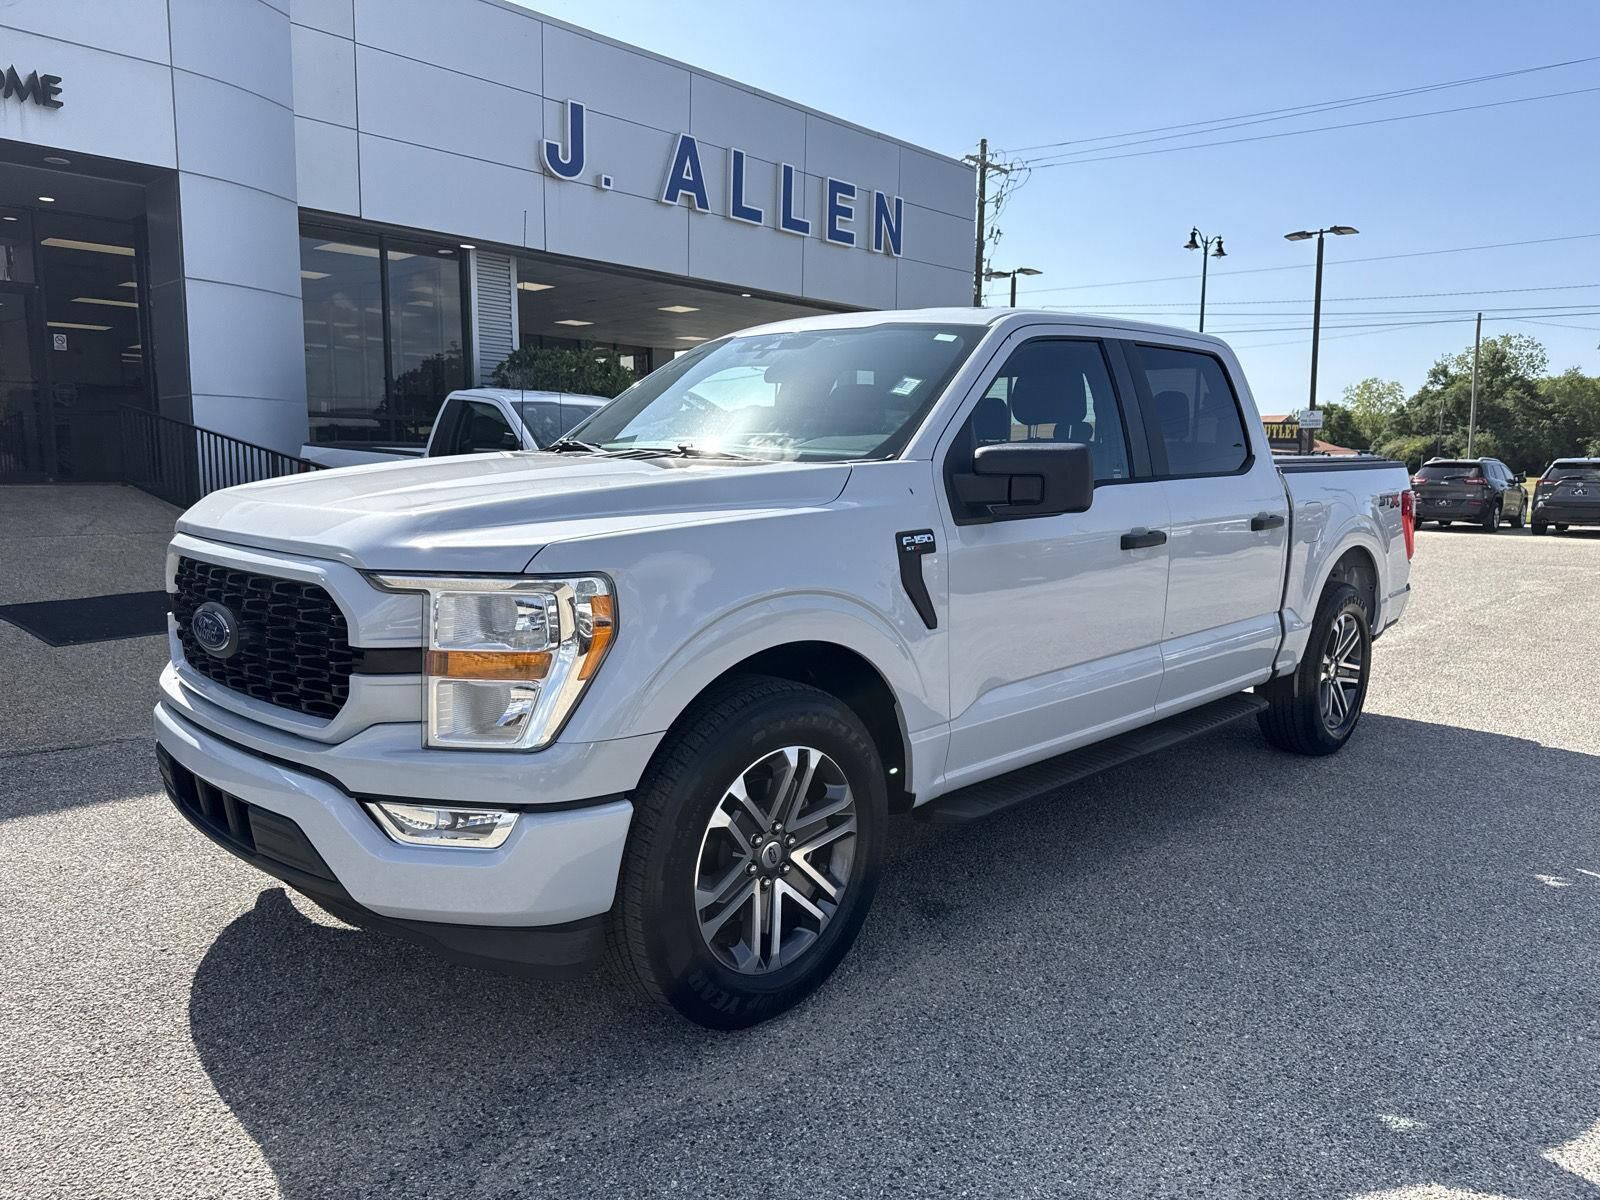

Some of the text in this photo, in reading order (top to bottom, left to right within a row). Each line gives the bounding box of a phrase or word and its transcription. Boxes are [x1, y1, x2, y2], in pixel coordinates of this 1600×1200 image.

[0, 64, 64, 109] ME
[540, 99, 903, 257] J. ALLEN
[1379, 494, 1400, 508] STX
[903, 534, 934, 545] F-150
